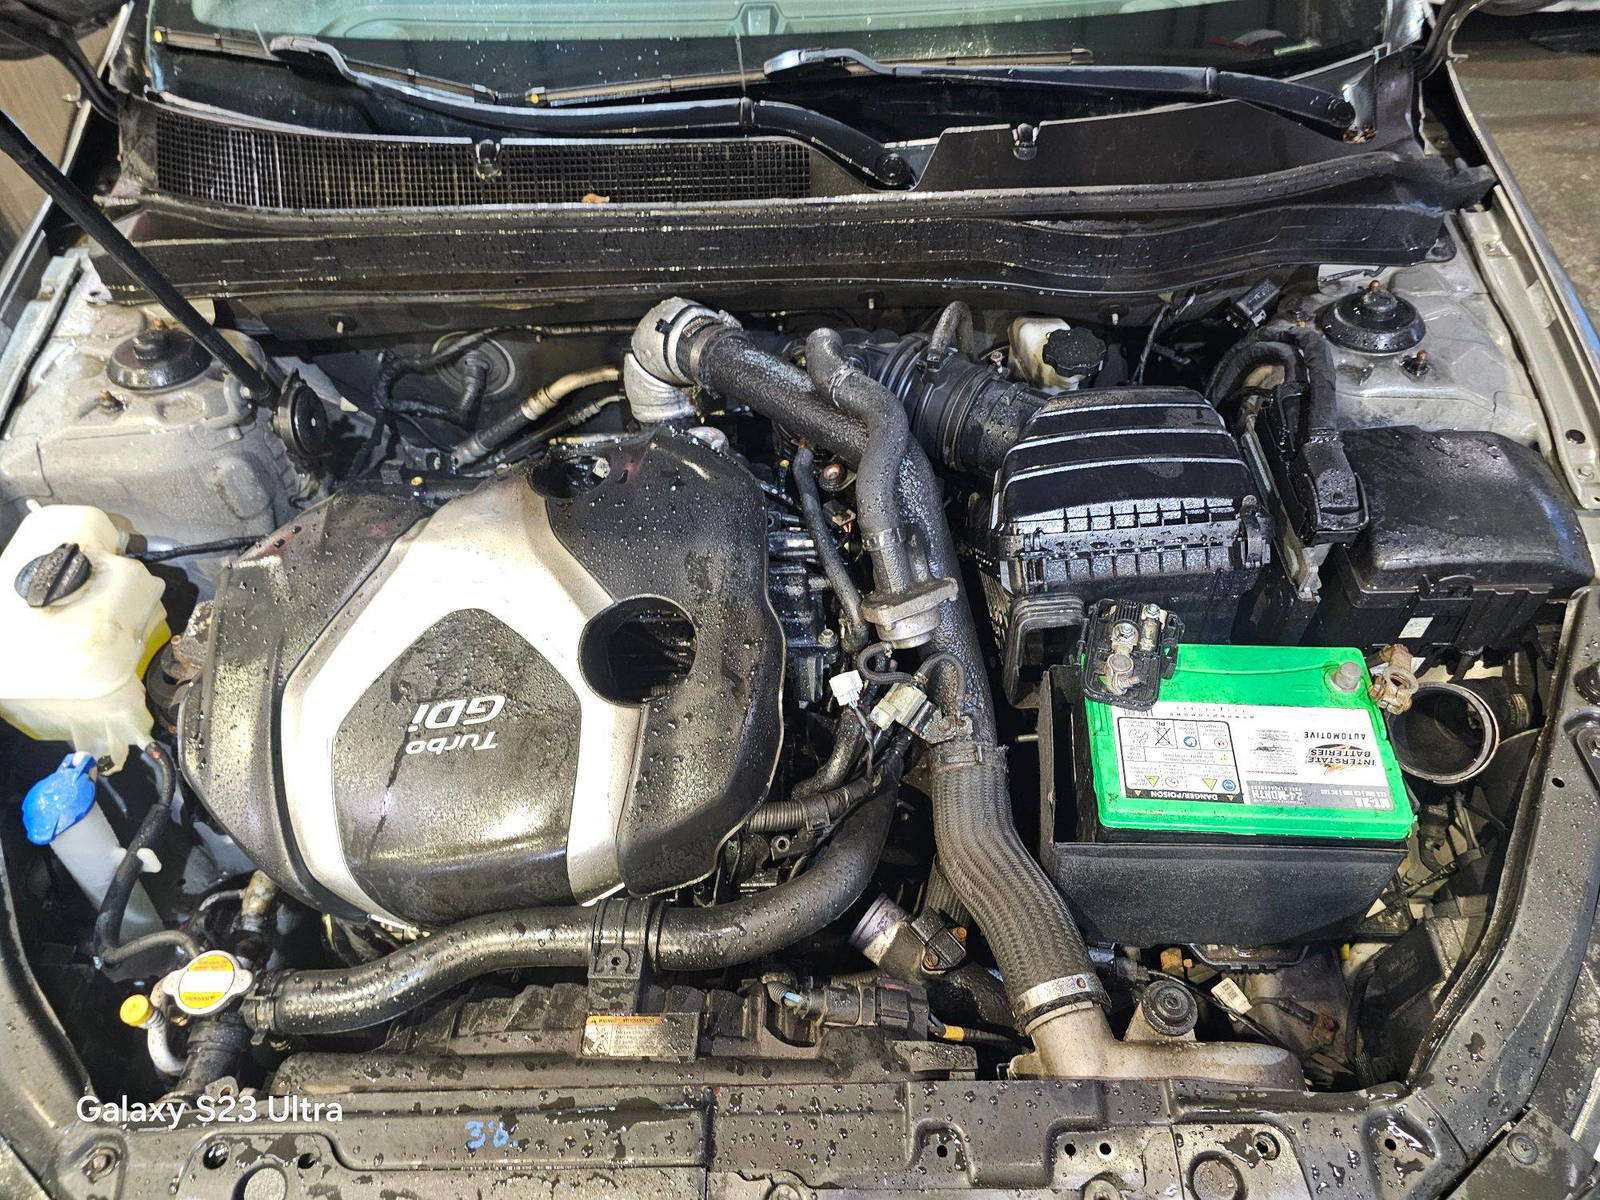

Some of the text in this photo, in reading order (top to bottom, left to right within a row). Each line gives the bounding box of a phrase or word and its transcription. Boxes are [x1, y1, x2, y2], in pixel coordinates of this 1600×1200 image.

[1303, 731, 1366, 741] AUTOMOTIVE
[405, 731, 499, 755] Turbo
[1310, 748, 1371, 758] BATTERIES
[1306, 757, 1376, 767] INTERSTATE
[1150, 790, 1219, 801] DANGER/POISON
[1252, 789, 1303, 801] 24-MONTH
